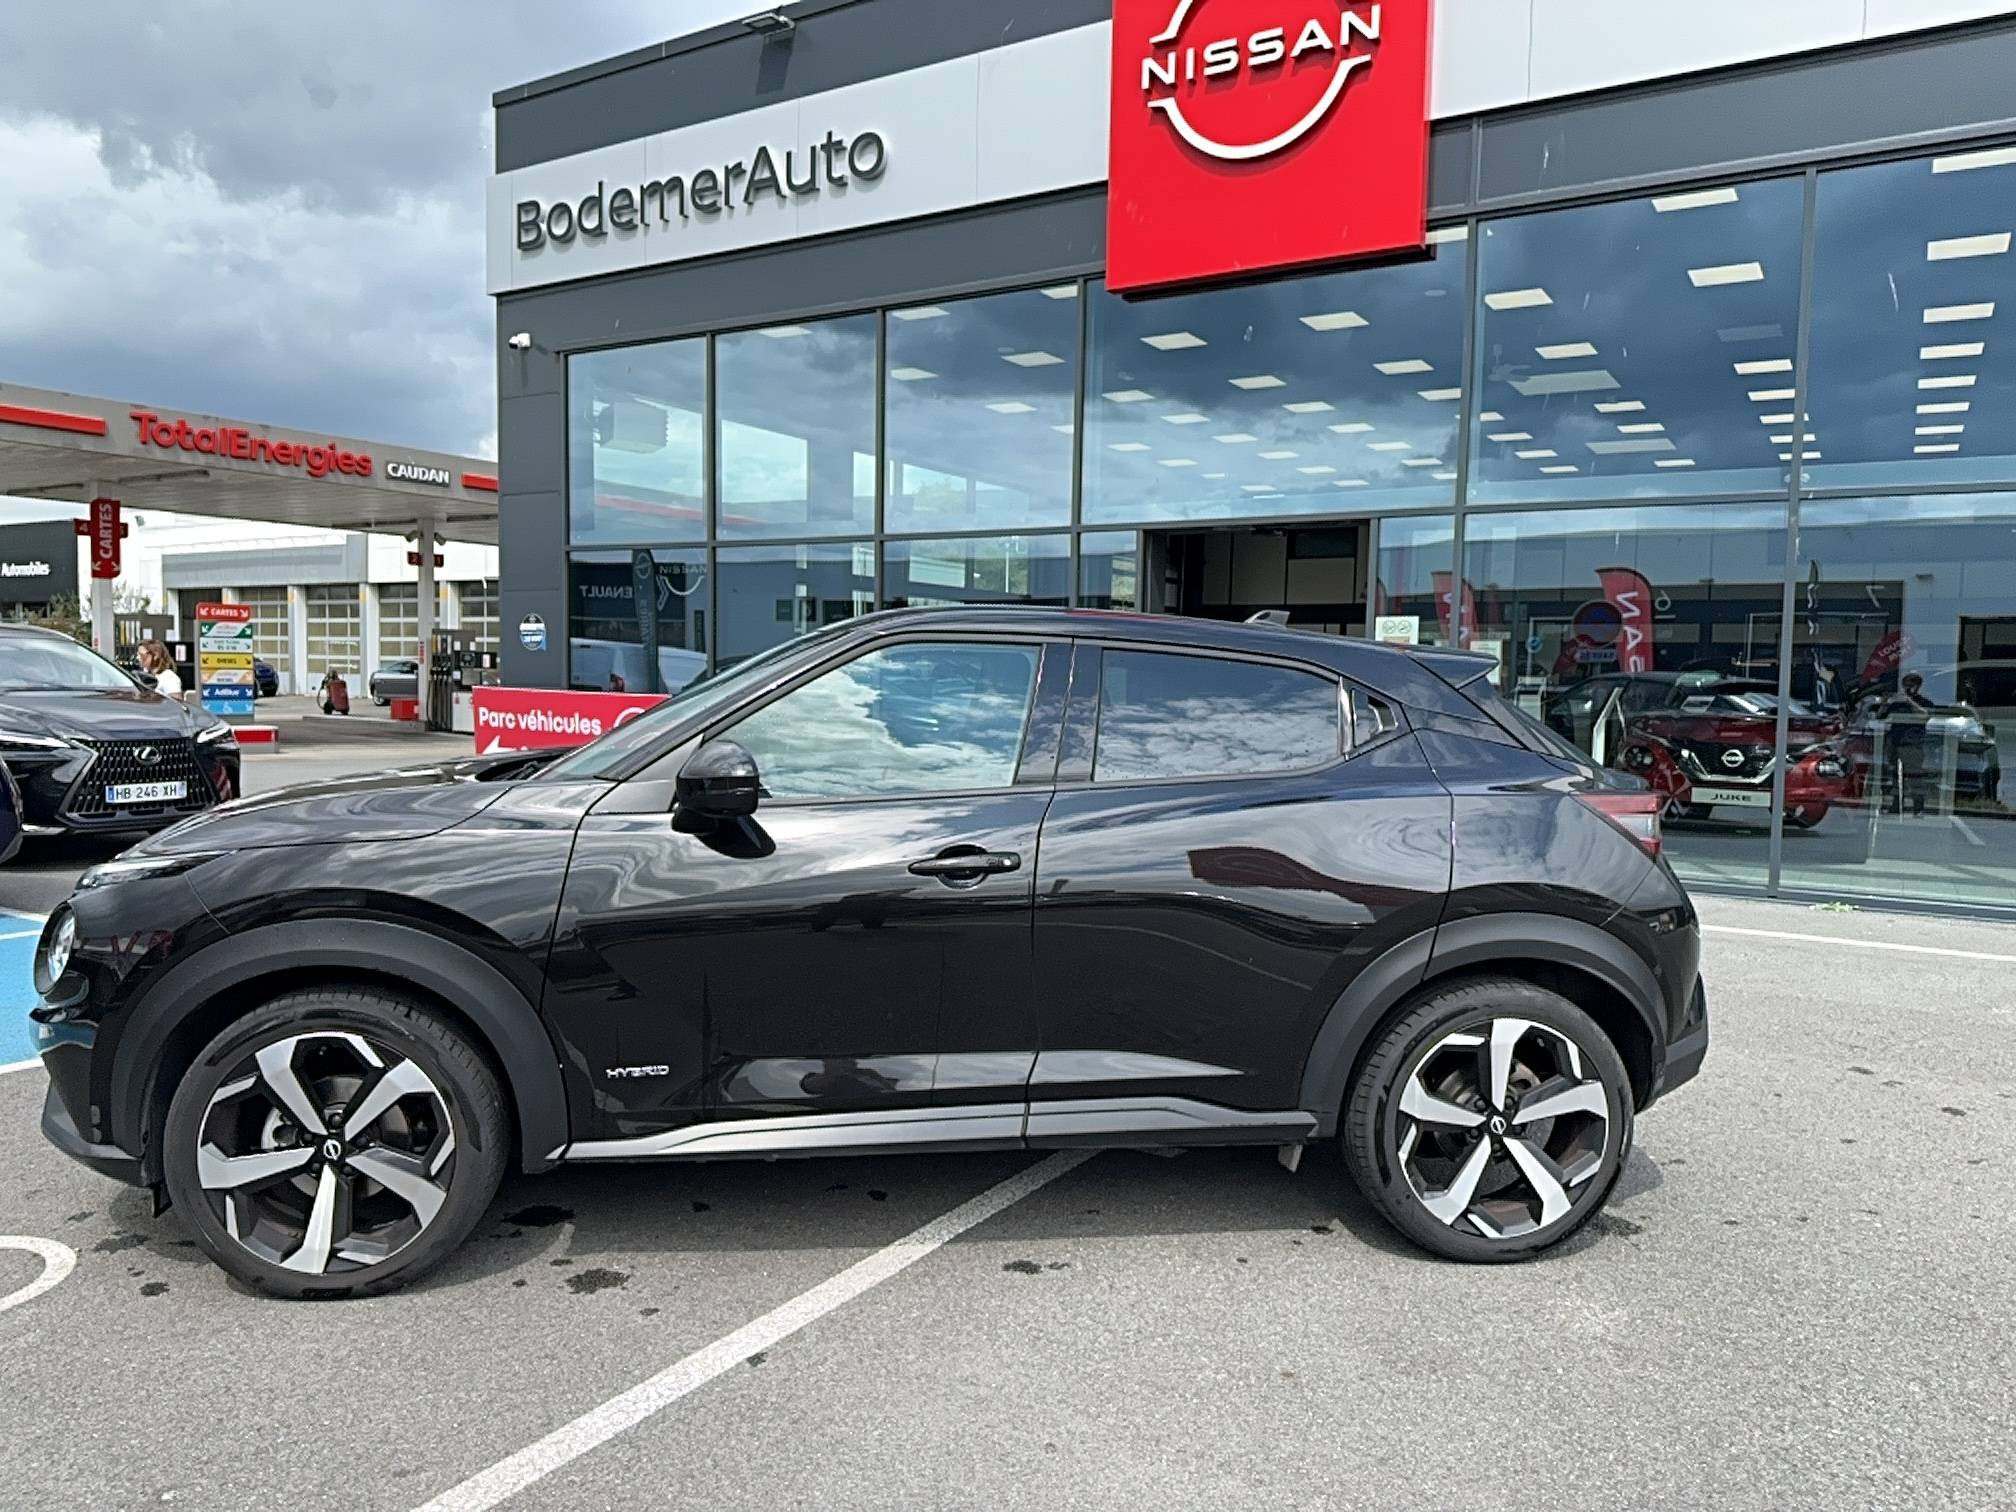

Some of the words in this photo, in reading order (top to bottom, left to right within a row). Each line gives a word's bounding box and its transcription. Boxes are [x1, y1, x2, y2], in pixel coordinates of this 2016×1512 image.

[1141, 4, 1381, 89] NISSAN
[516, 131, 886, 251] BodemerAuto
[130, 411, 373, 477] TotalEnergies
[386, 462, 450, 484] CAUDAN
[99, 503, 112, 559] CARTES
[659, 565, 706, 575] NISSAN
[210, 608, 238, 617] CARTES
[479, 706, 516, 729] Parc
[517, 709, 602, 735] véhicules
[116, 787, 131, 800] HB
[136, 785, 158, 798] 246
[163, 784, 177, 796] XH
[1711, 793, 1752, 802] JUKE
[605, 1065, 669, 1079] HYBRID
